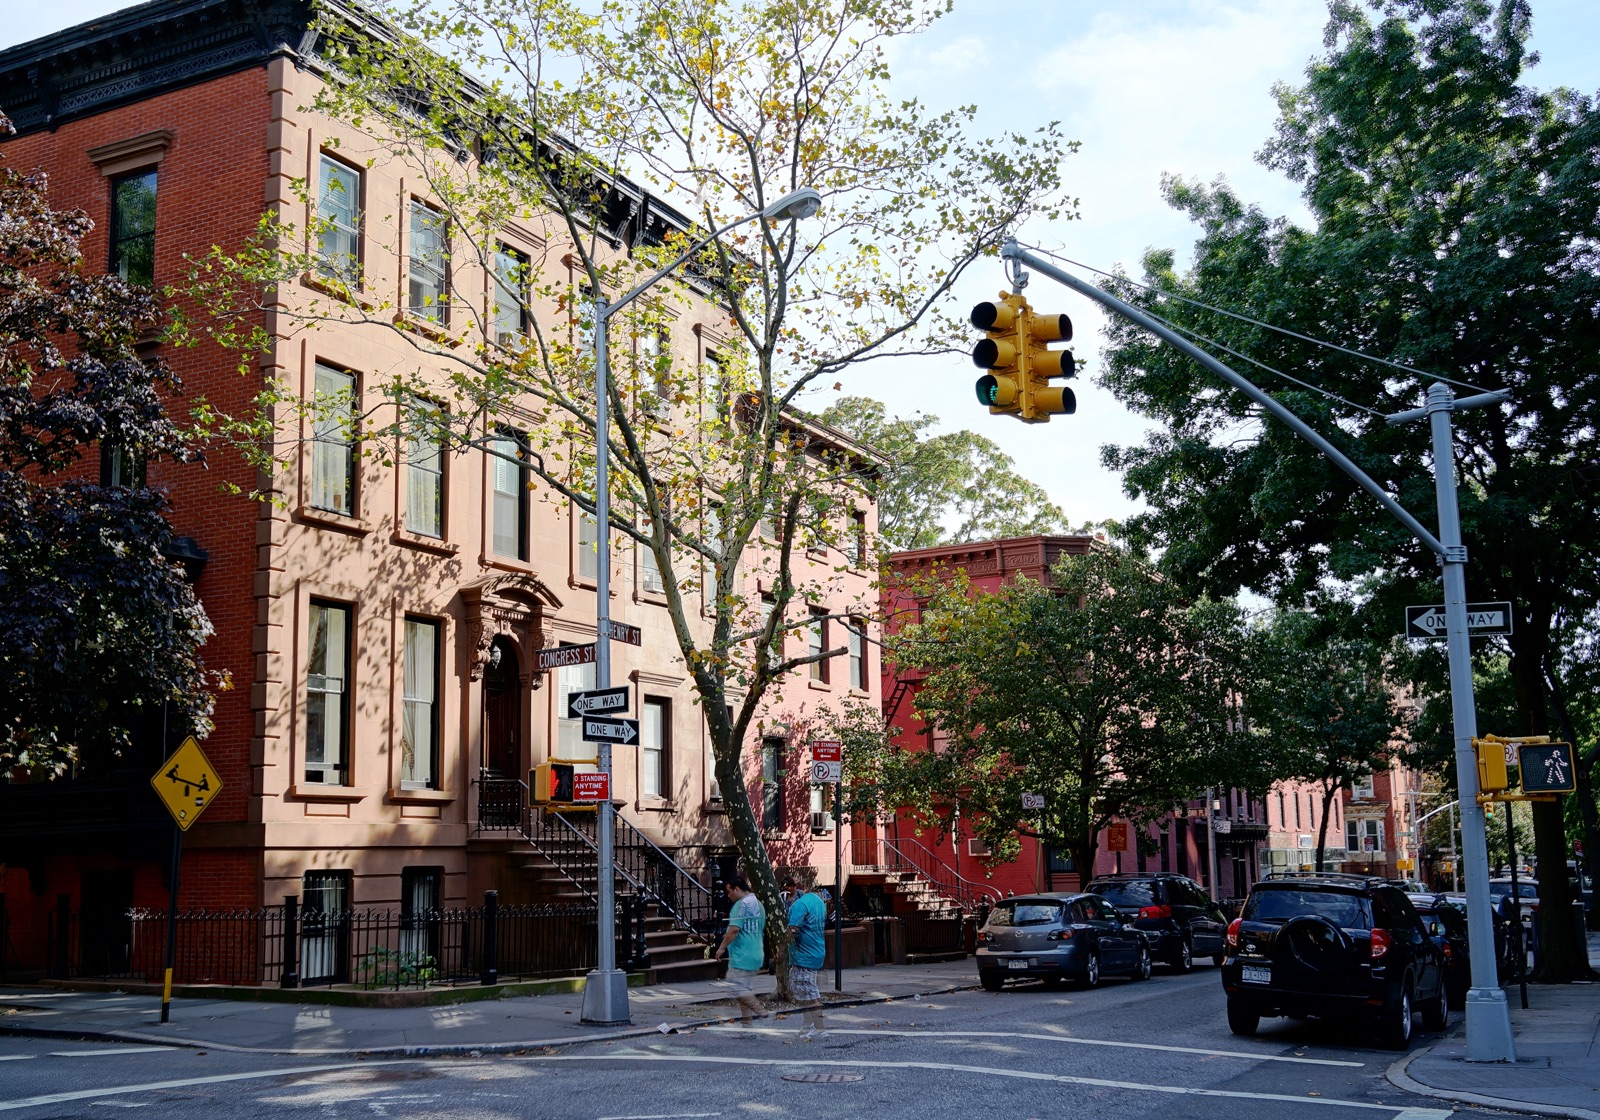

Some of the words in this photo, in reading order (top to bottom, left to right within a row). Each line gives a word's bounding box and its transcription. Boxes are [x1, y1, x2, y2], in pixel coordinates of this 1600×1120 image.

[1426, 615, 1446, 628] ON
[1467, 613, 1496, 626] WAY
[609, 623, 629, 642] HENRY
[632, 629, 640, 645] ST
[539, 648, 581, 668] CONGRESS
[584, 646, 594, 662] ST
[576, 698, 594, 710] ONE
[602, 695, 621, 707] WAY
[590, 723, 608, 736] ONE
[614, 726, 631, 737] WAY
